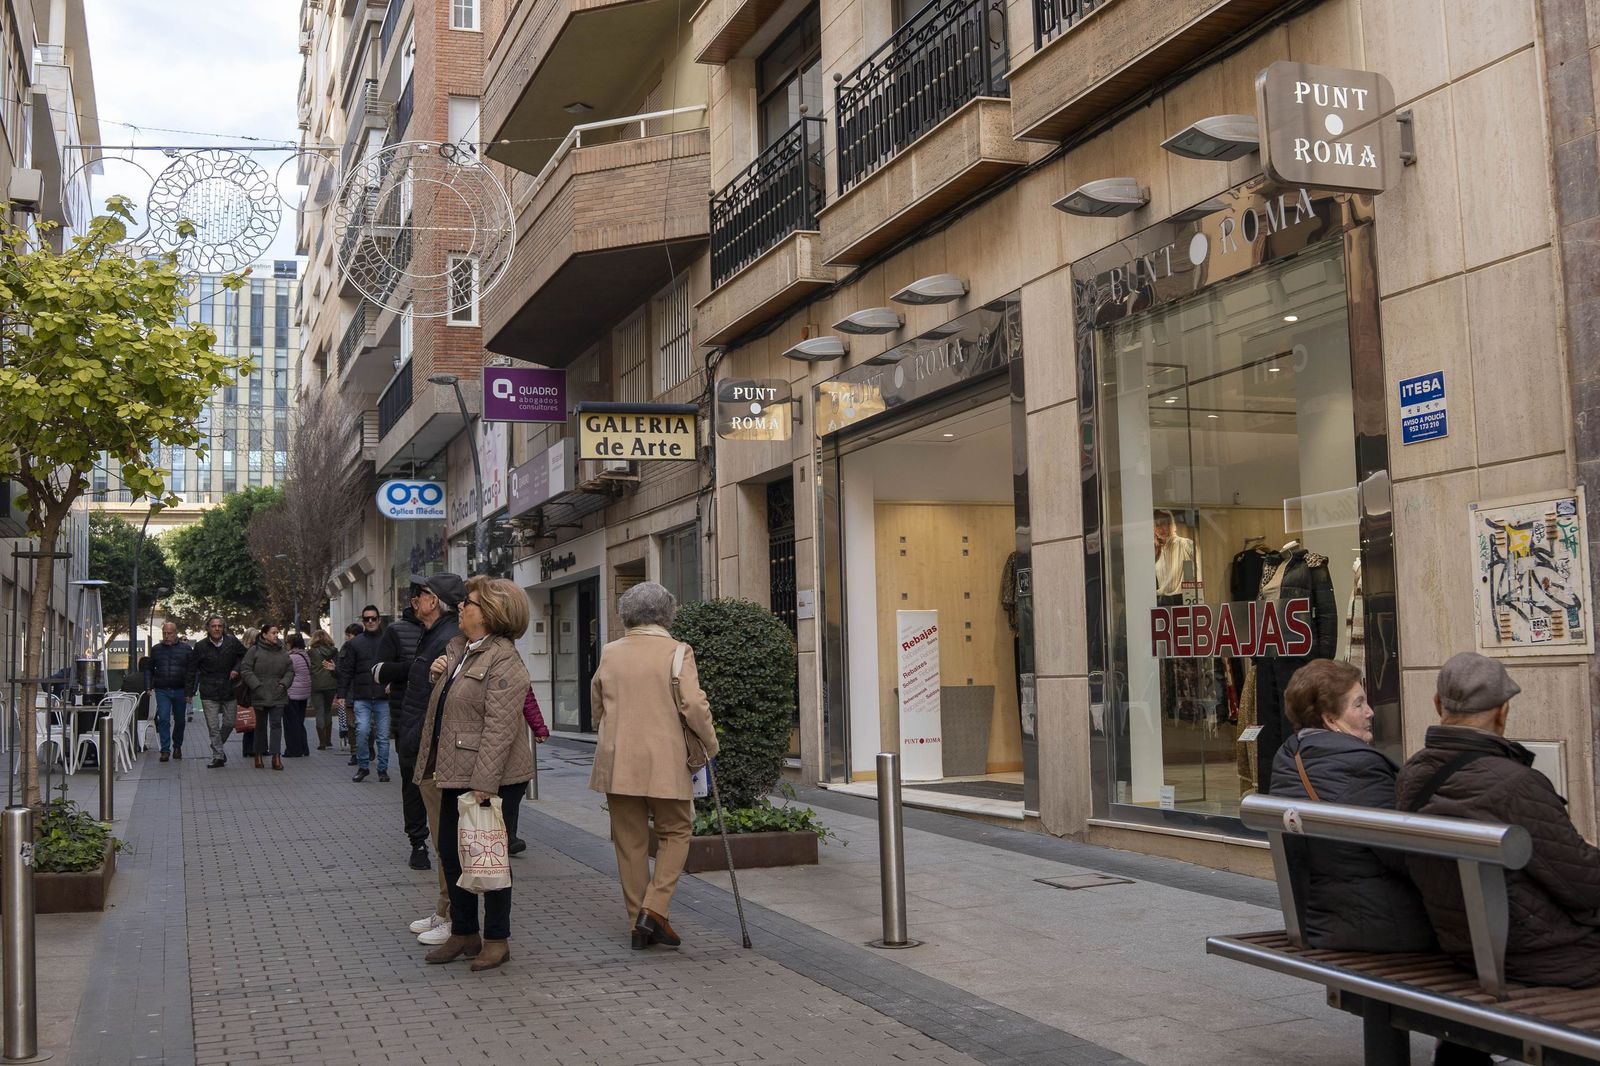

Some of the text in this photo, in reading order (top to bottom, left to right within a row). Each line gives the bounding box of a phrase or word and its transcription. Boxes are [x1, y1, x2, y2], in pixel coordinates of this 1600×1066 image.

[1294, 81, 1368, 111] PUNT
[1294, 138, 1377, 168] ROMA
[1219, 188, 1316, 256] ROMA
[914, 338, 964, 382] ROMA
[519, 386, 558, 396] QUADRO
[733, 386, 777, 401] PUNT
[1402, 377, 1441, 398] ITESA
[519, 397, 558, 405] abogados
[519, 403, 558, 411] consultores
[585, 415, 689, 434] GALERIA
[731, 416, 779, 430] ROMA
[1403, 418, 1419, 427] AVISO
[595, 437, 682, 456] de Arte
[1150, 597, 1314, 658] REBAJAS
[901, 625, 938, 651] Rebajas
[902, 660, 928, 679] Rebaixes
